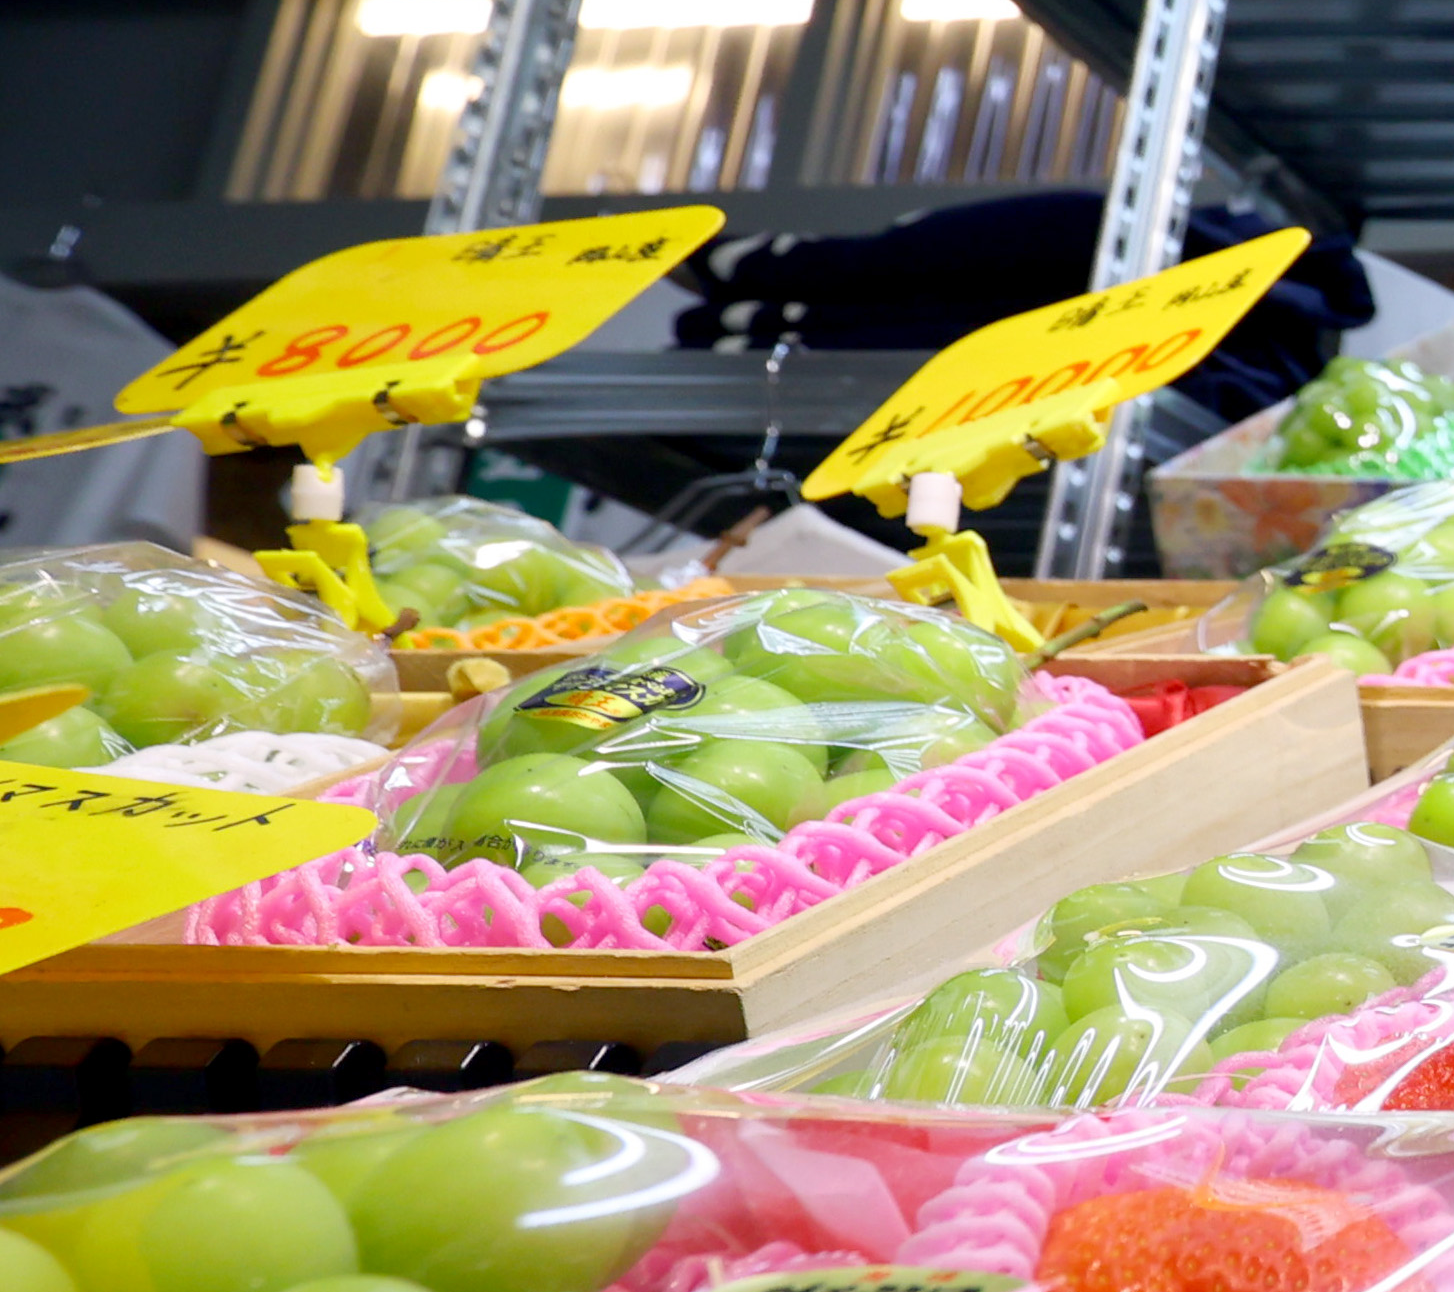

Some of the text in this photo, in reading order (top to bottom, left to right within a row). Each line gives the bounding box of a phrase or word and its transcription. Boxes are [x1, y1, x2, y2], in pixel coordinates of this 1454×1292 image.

[156, 311, 551, 391] ¥8000
[0, 779, 297, 832] マスカット
